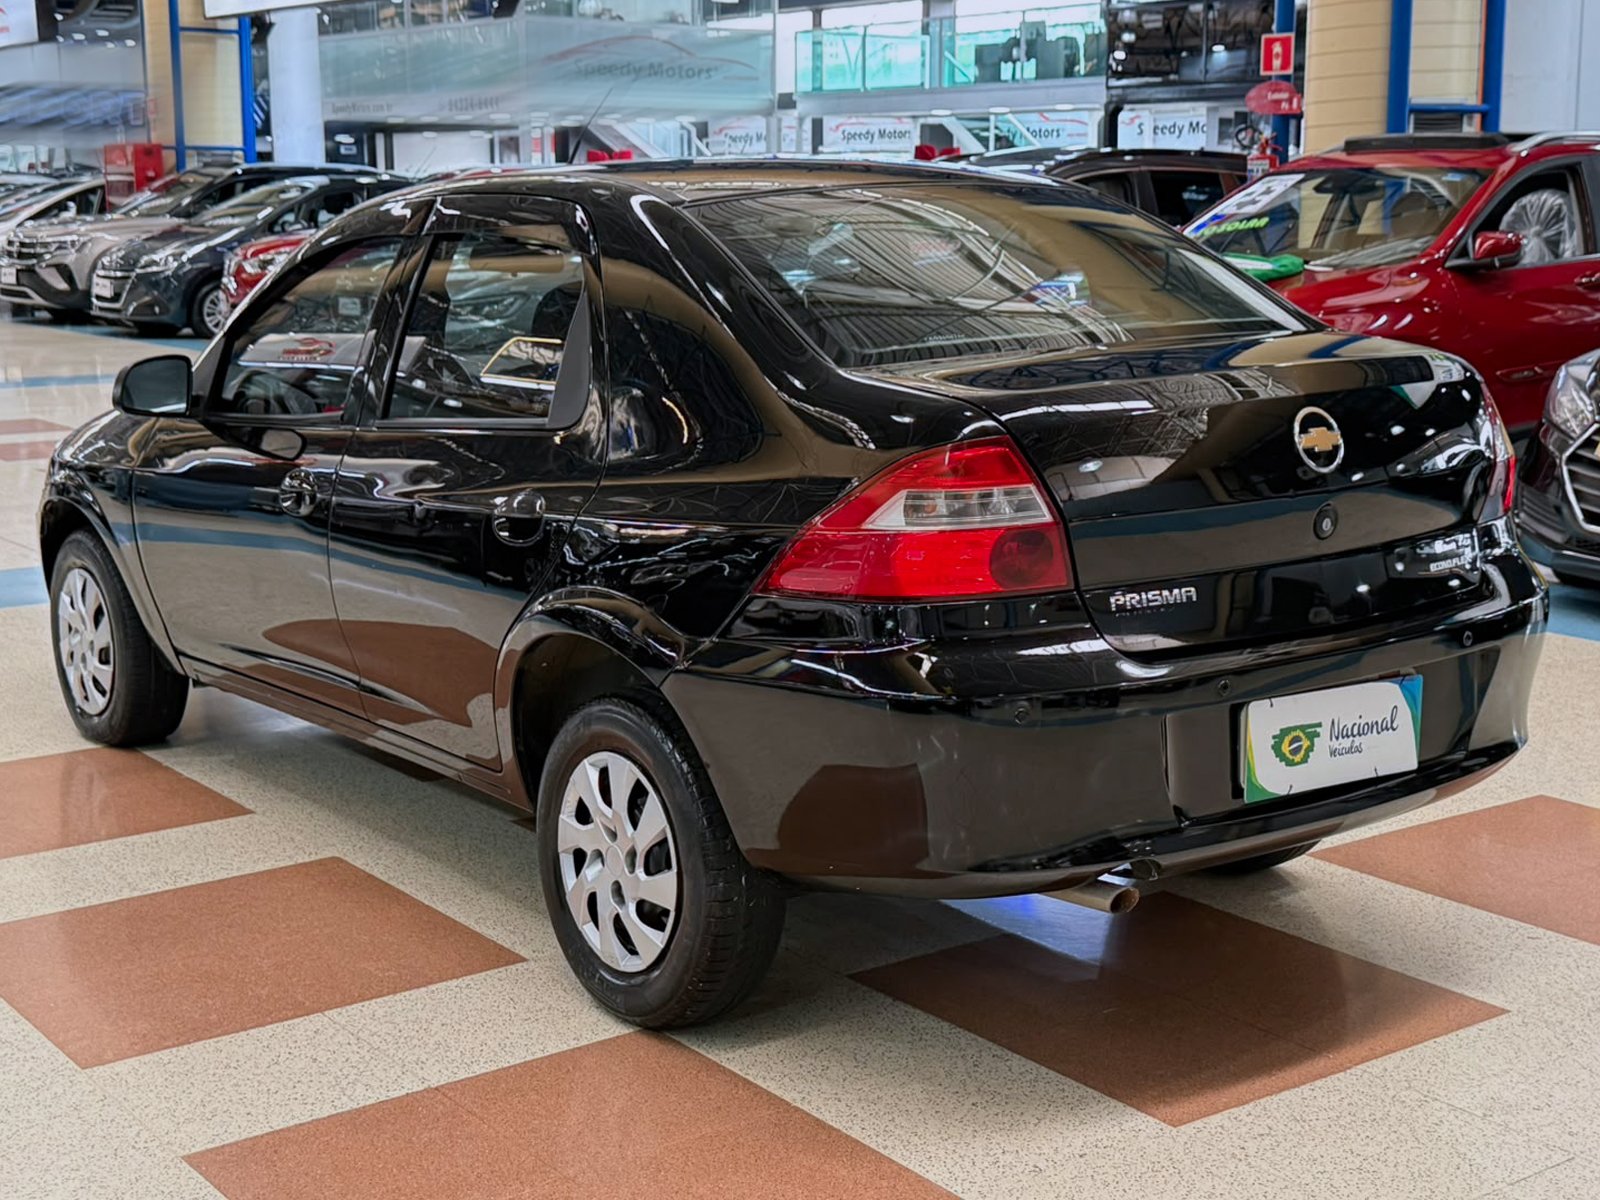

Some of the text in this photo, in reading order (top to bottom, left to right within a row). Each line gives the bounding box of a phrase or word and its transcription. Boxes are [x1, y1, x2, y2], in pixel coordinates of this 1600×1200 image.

[574, 59, 714, 83] Speedy Motors
[841, 128, 875, 143] Speedy
[1137, 122, 1185, 139] Seedy
[1109, 587, 1197, 611] PRISMA
[1329, 705, 1399, 742] Nacional
